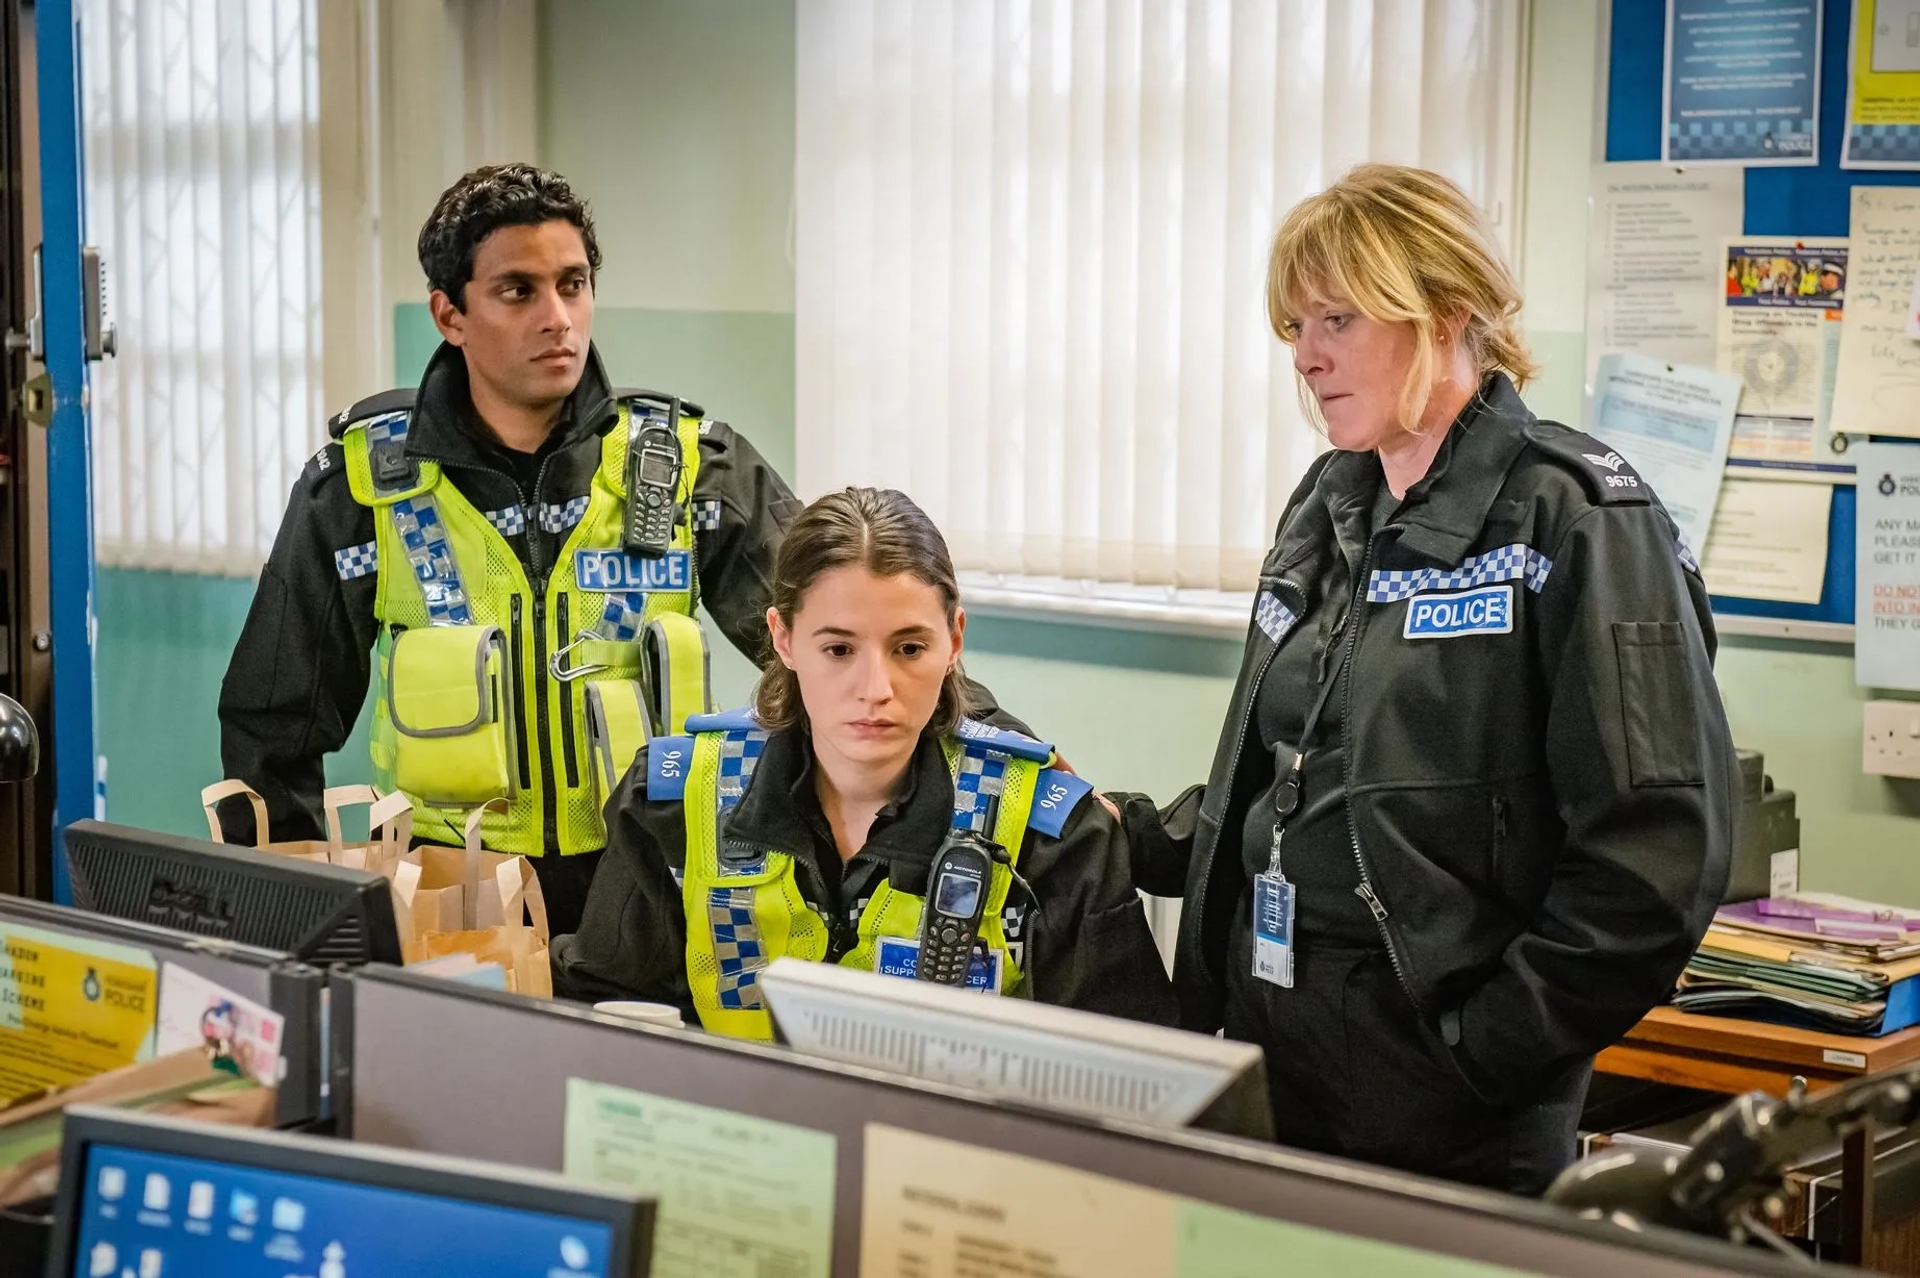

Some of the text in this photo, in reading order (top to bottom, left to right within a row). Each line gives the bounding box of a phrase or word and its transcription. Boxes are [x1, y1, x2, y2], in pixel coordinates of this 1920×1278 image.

[1604, 474, 1638, 488] 9675
[1875, 519, 1920, 531] ANY MA
[1873, 551, 1916, 564] GET IT
[582, 555, 683, 587] POLICE
[1873, 584, 1893, 597] DO
[1414, 597, 1502, 629] POLICE
[1874, 617, 1908, 630] THEY
[661, 750, 682, 778] 965
[1040, 783, 1068, 811] 965
